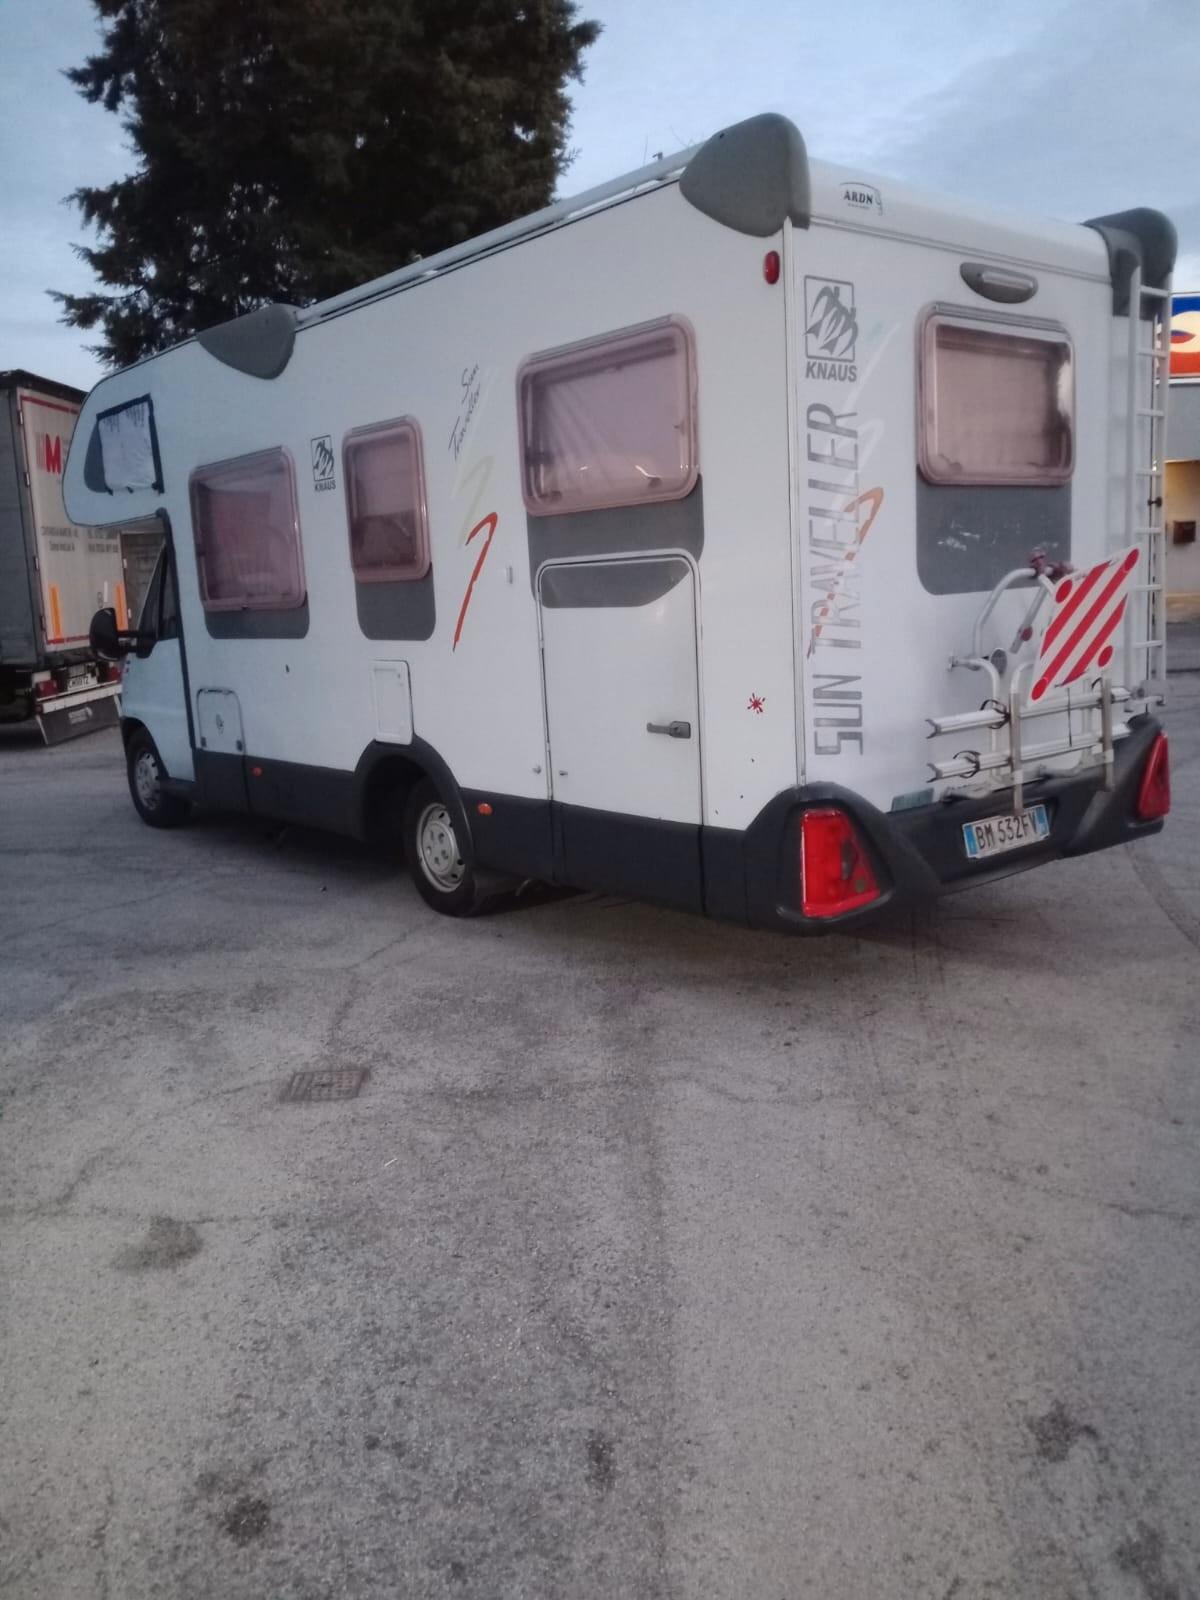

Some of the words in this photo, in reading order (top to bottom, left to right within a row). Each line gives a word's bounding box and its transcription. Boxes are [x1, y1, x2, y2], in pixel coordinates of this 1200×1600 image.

[805, 361, 857, 382] KNAUS
[806, 403, 861, 654] TRAVELLER
[812, 674, 863, 755] SUN
[975, 823, 996, 850] BM
